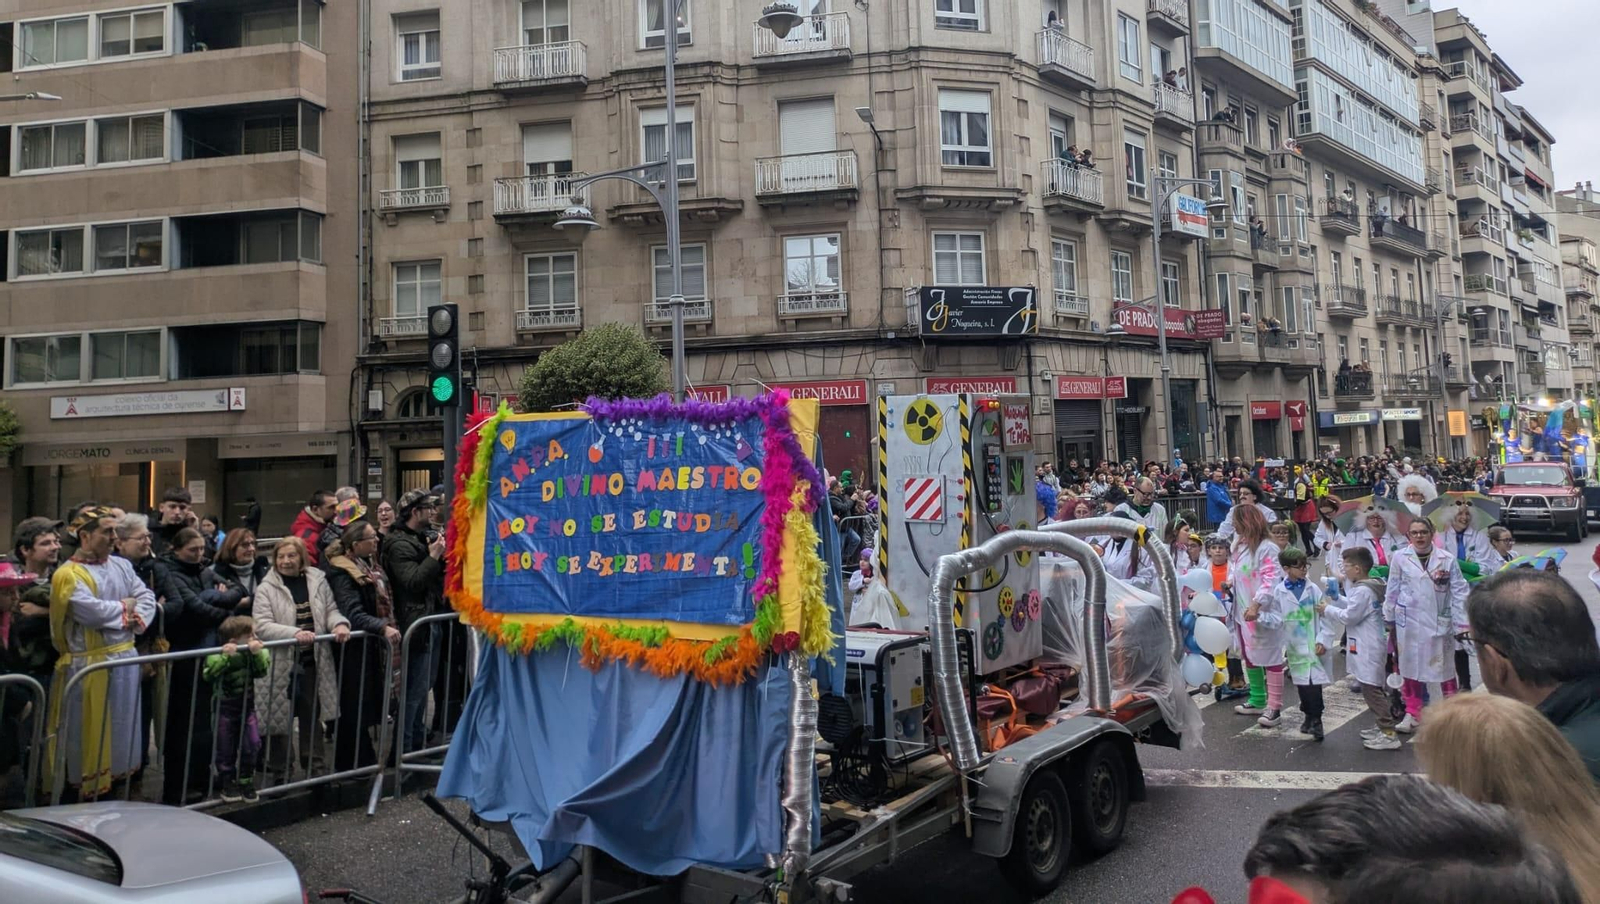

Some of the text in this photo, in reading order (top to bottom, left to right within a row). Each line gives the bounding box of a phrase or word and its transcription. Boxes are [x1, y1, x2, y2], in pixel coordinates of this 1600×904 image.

[1119, 310, 1131, 326] DE
[1163, 317, 1185, 333] bogados
[791, 386, 860, 401] GENERALI
[950, 382, 1013, 394] GENERALI
[1070, 381, 1101, 395] GENERALI
[541, 465, 763, 503] DIVINO MAESTRO
[498, 508, 739, 540] HOY NO SE ESTUDIA
[556, 555, 582, 575] SE
